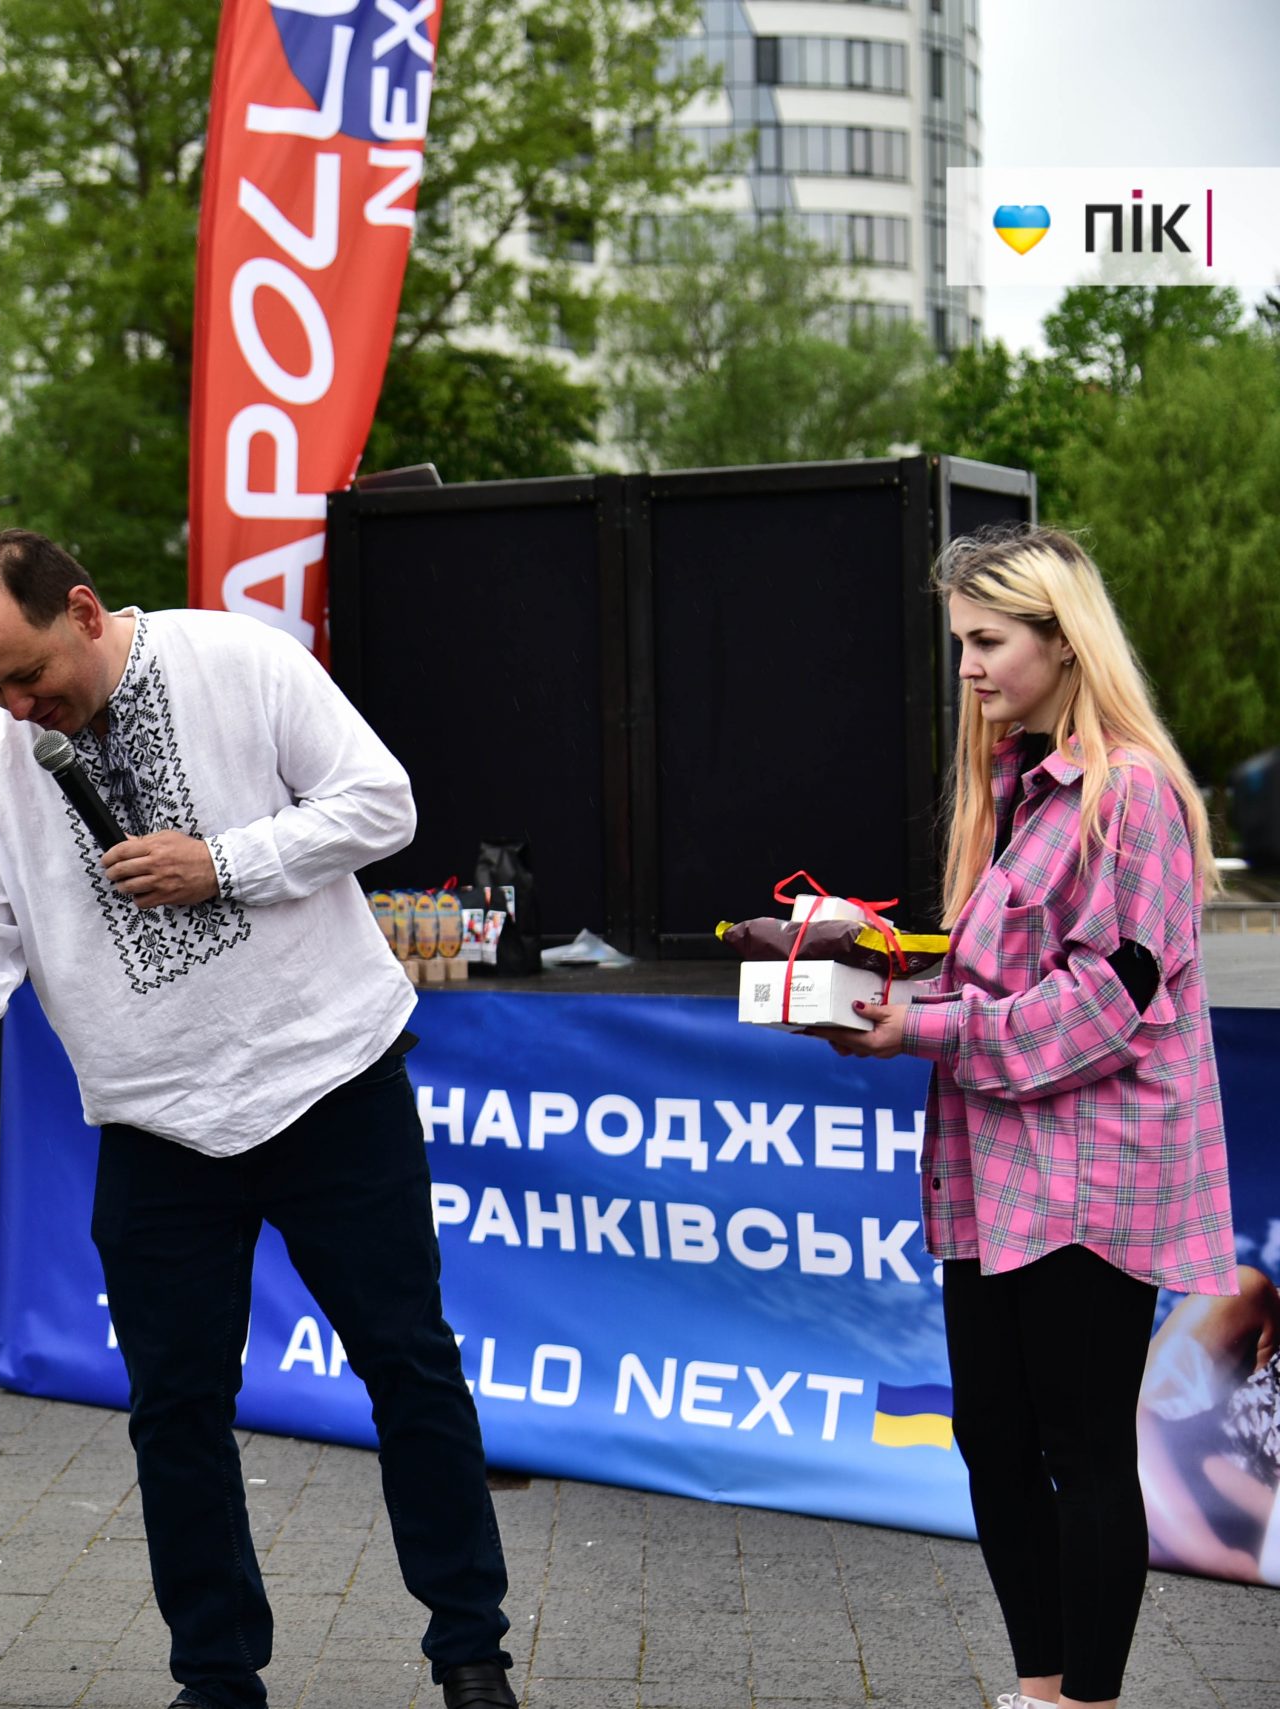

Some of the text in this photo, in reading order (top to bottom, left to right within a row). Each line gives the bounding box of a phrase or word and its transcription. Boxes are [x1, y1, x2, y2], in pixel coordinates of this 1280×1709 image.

[221, 0, 360, 652] APOLL
[431, 1182, 942, 1287] РАНКІВСЬК
[614, 1353, 864, 1441] NEXT
